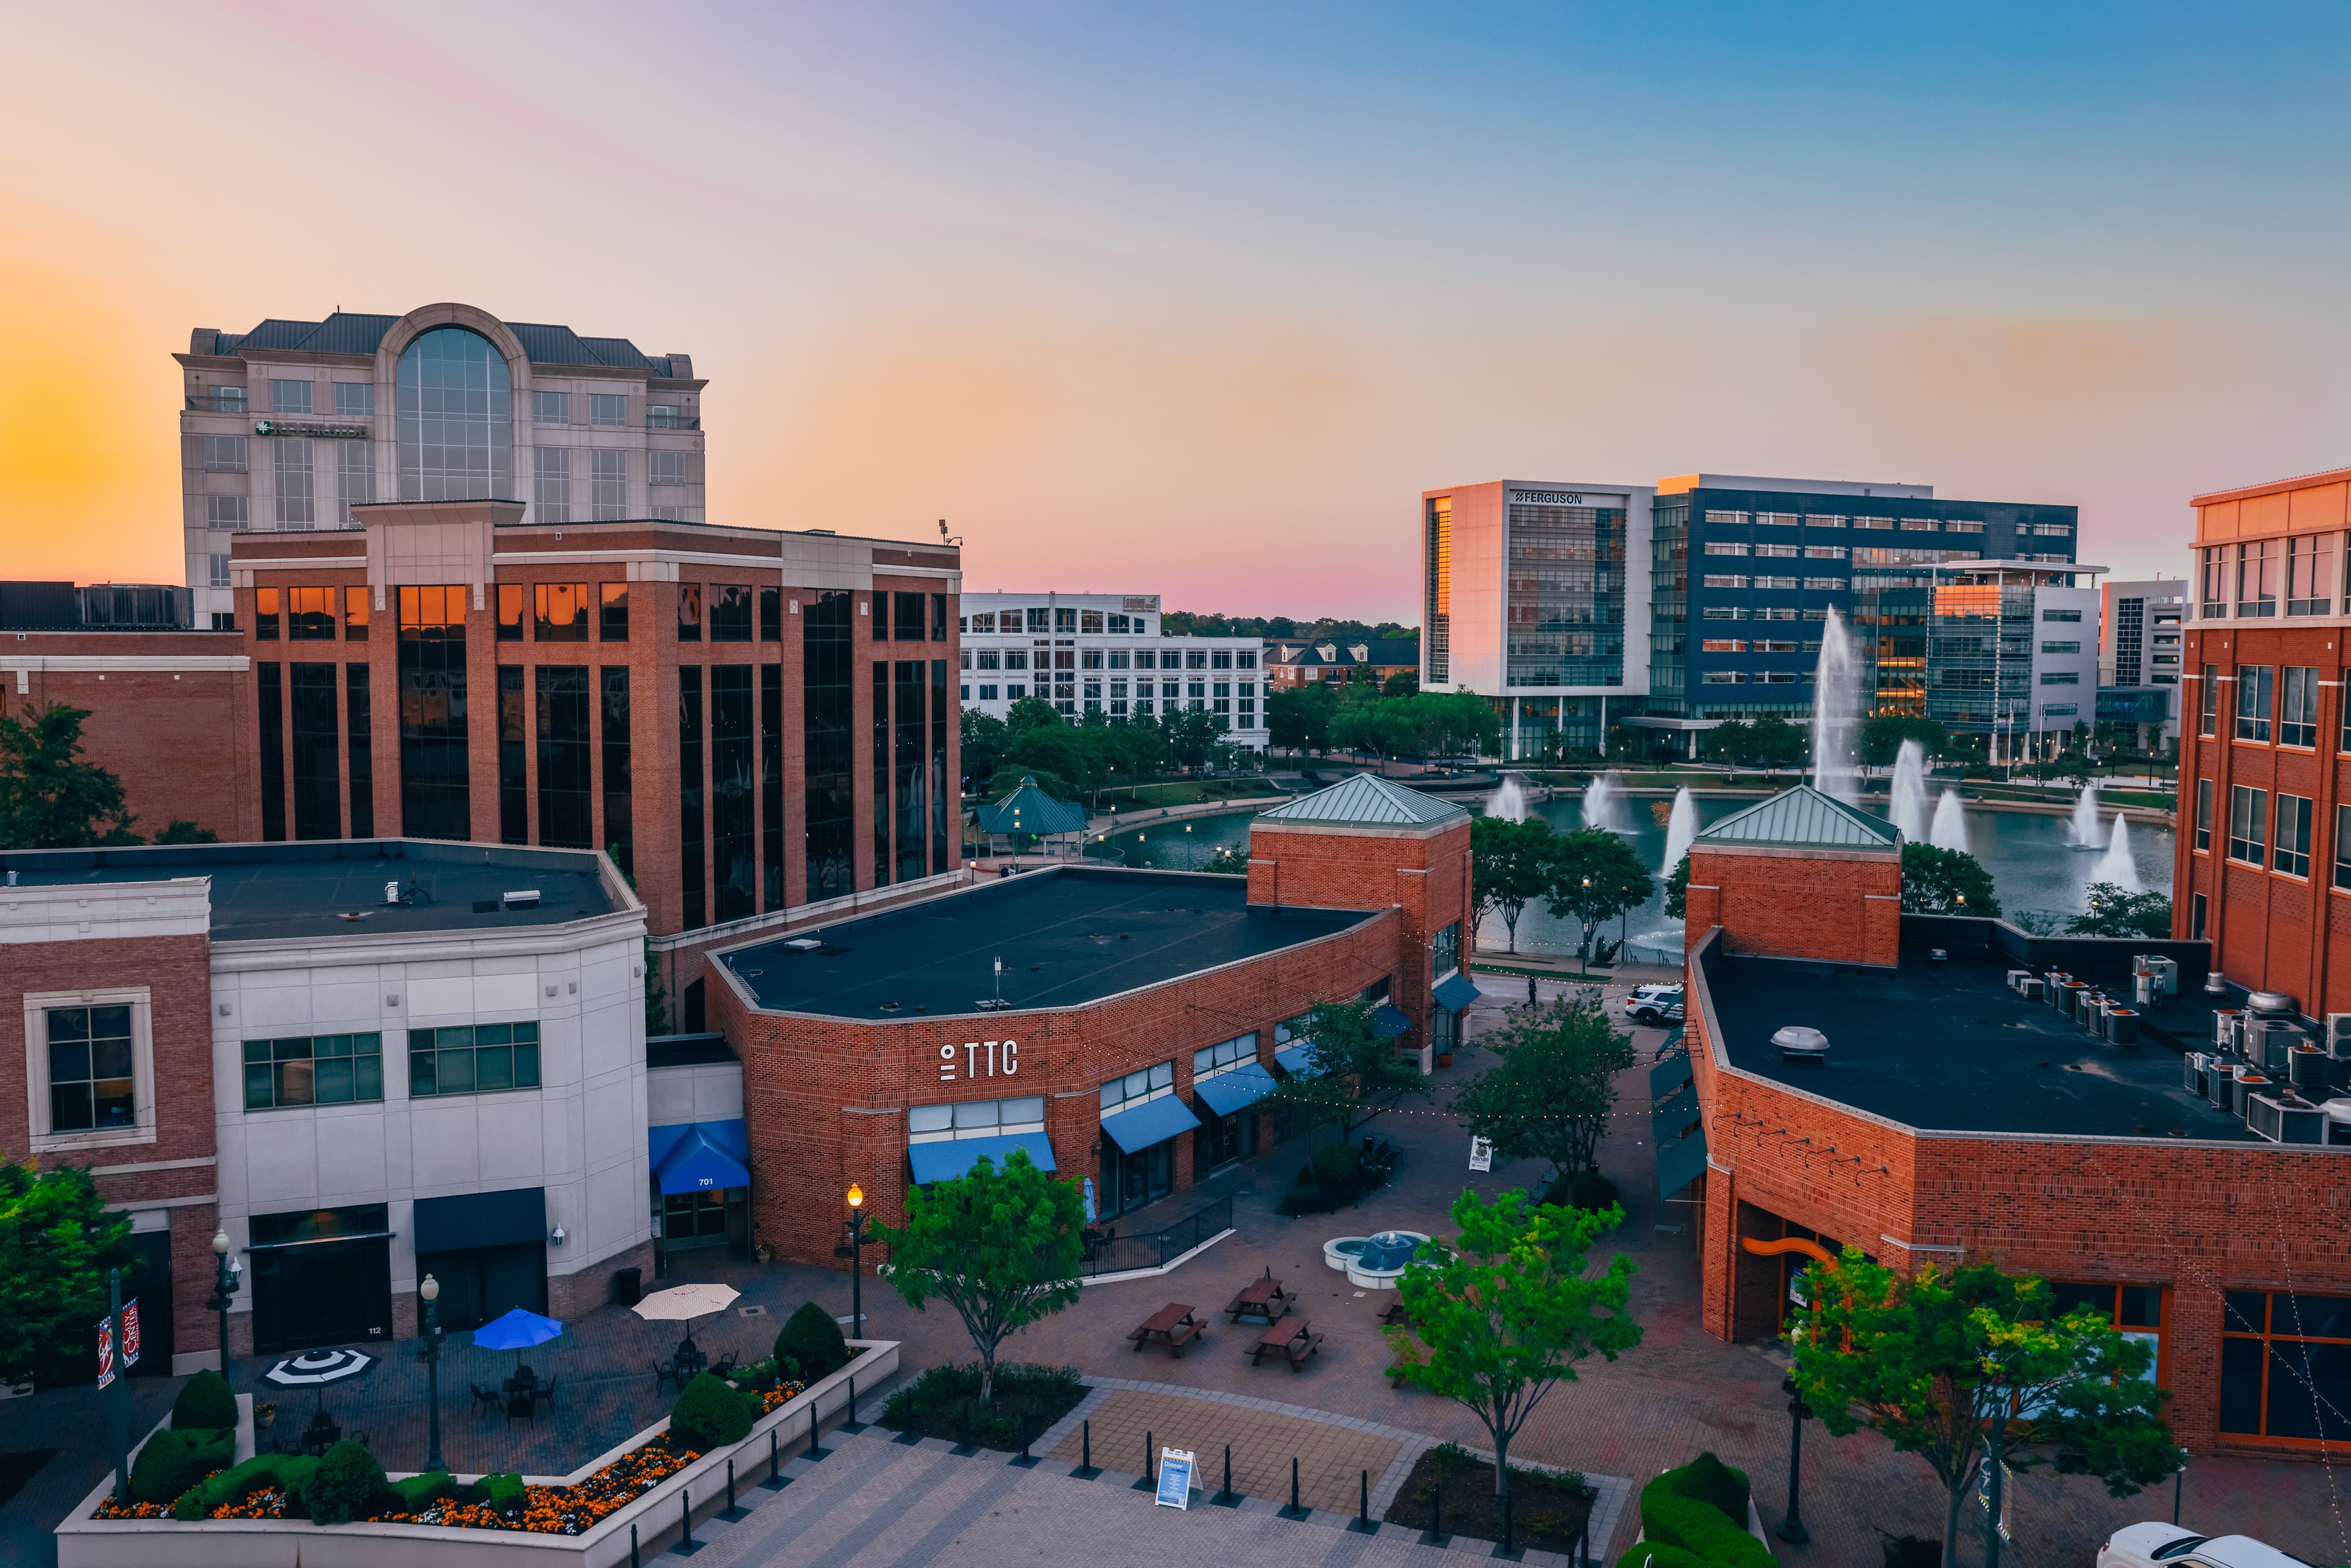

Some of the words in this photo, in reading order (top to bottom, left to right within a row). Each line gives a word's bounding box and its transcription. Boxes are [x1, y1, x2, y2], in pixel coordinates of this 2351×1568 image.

[272, 422, 367, 438] RIVERSIDE
[1524, 492, 1582, 505] FERGUSON
[1123, 596, 1146, 609] Langley
[699, 1177, 713, 1186] 701
[1164, 1461, 1183, 1469] Dinner
